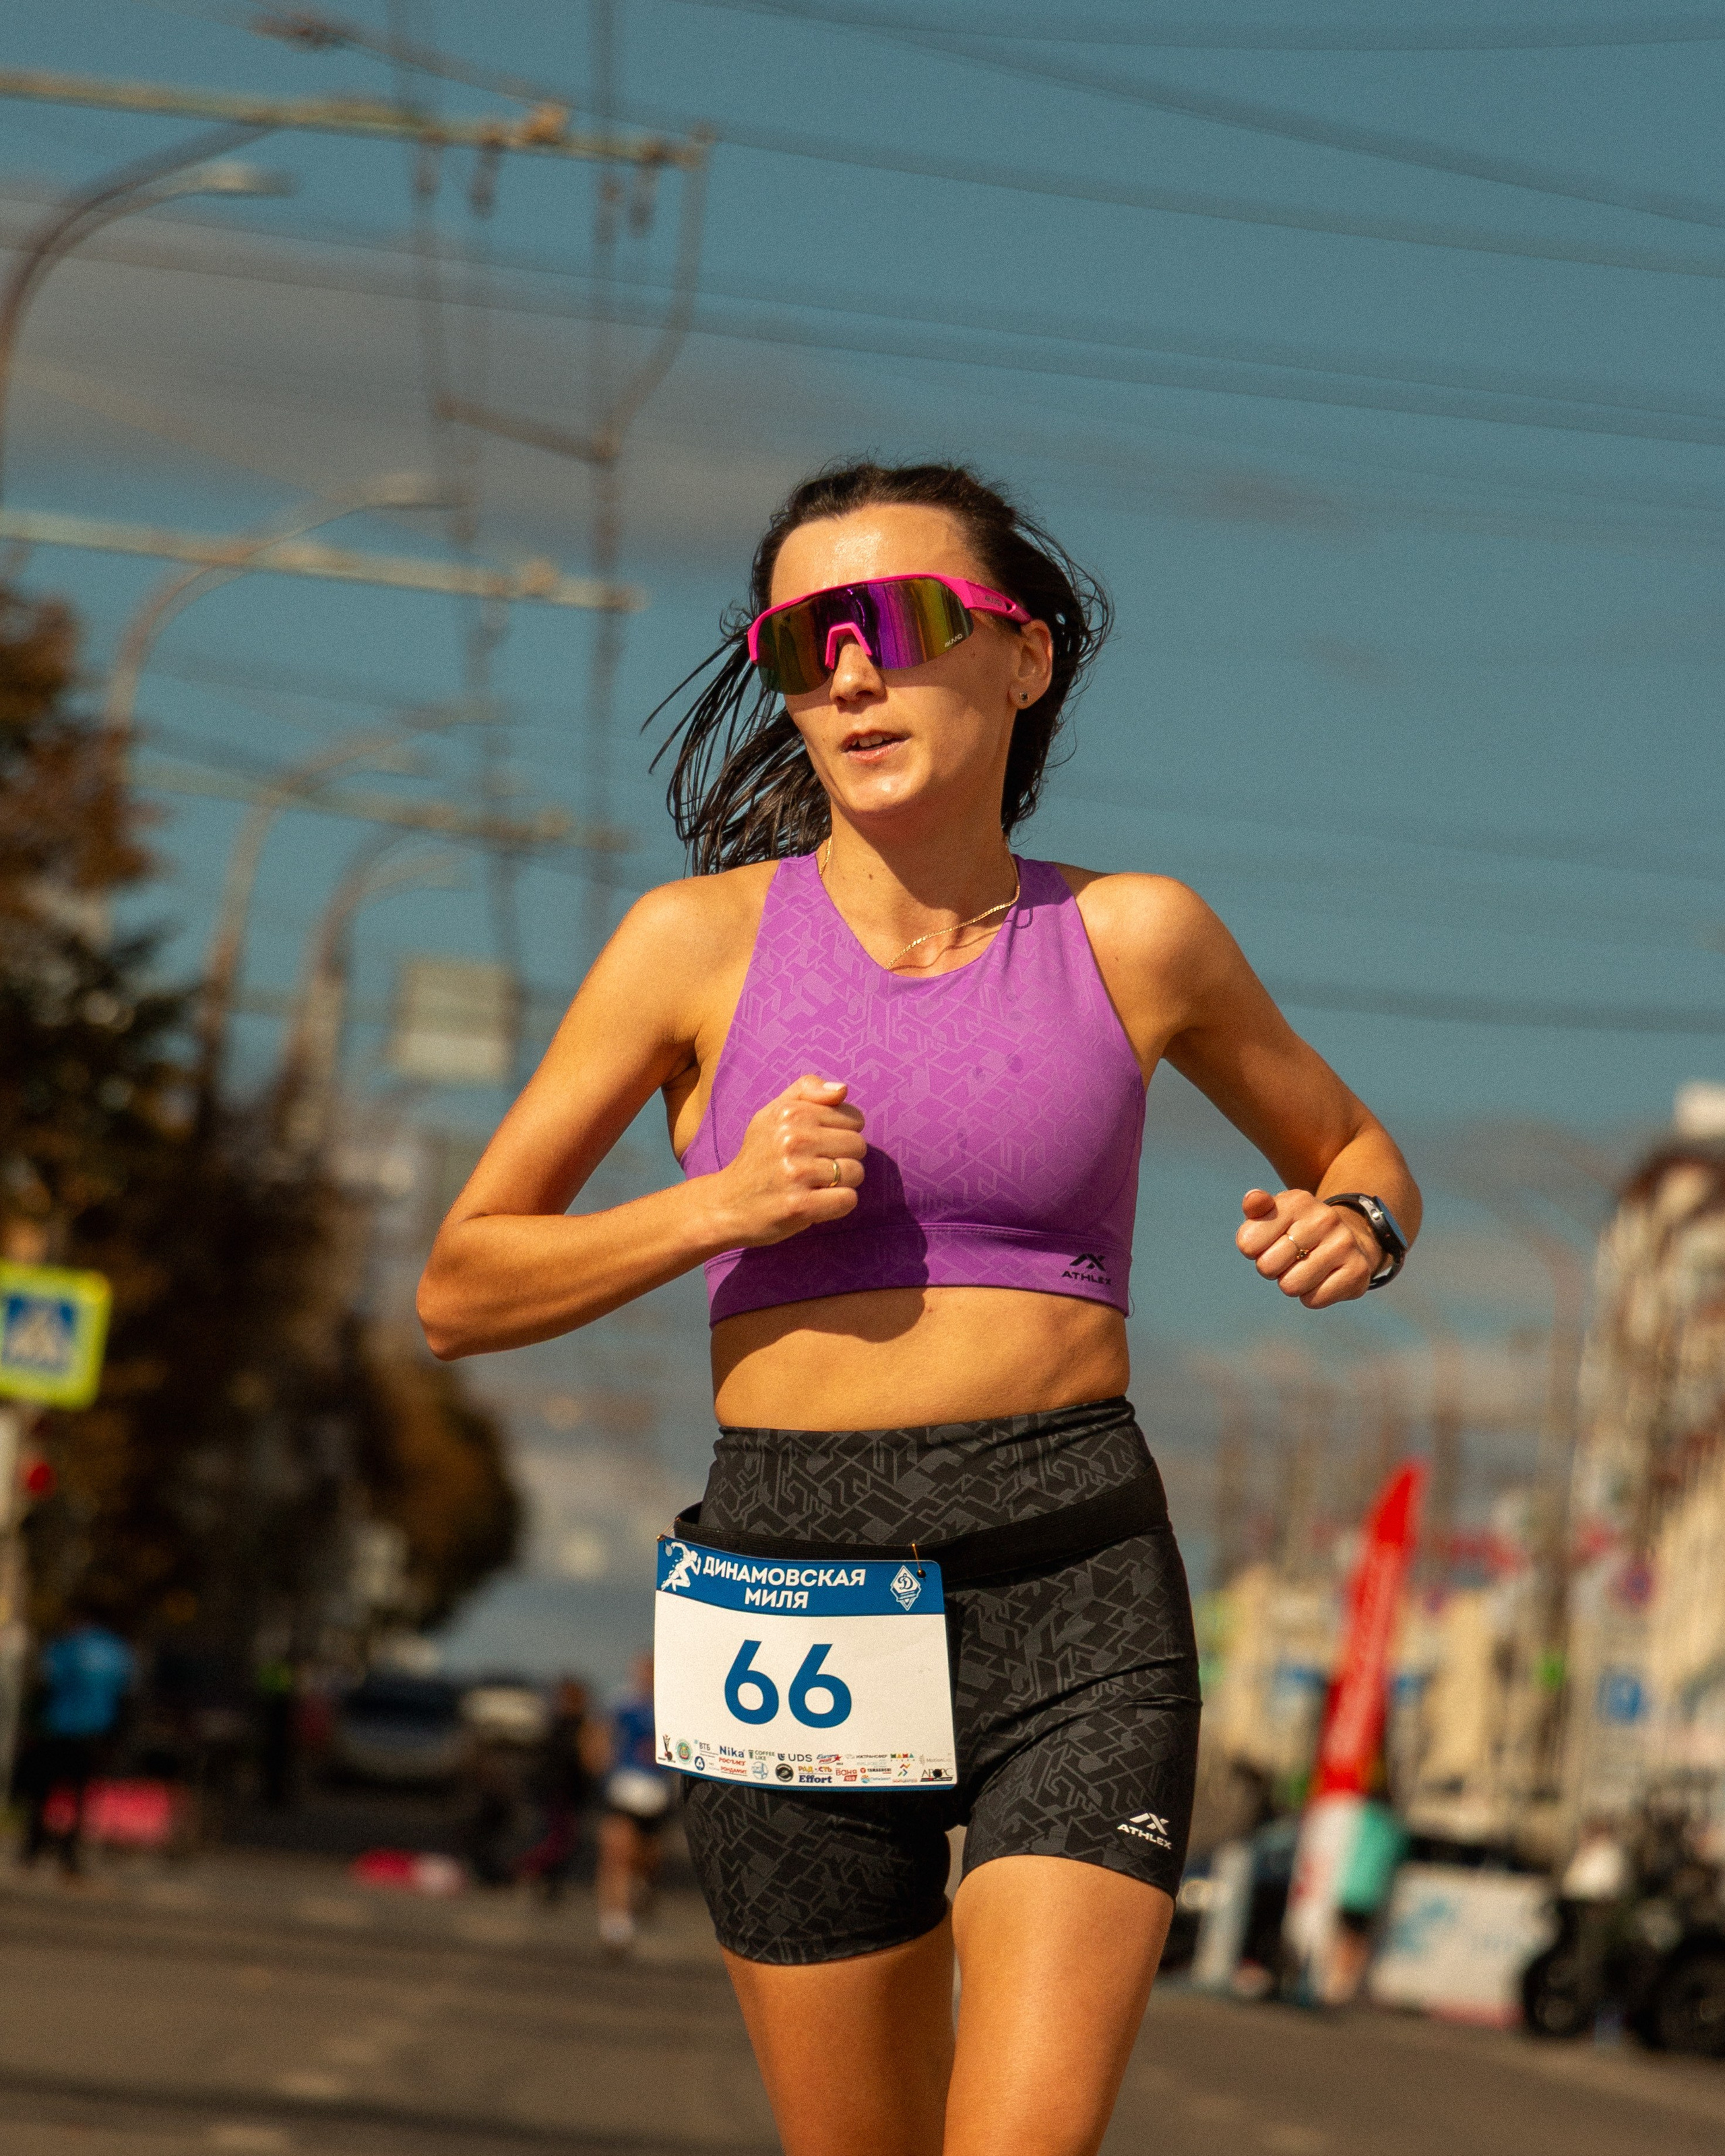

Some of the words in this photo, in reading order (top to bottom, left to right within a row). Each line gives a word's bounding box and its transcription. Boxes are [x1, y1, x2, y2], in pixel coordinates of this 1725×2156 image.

[1061, 1271, 1111, 1286] ATHLEX
[703, 1556, 866, 1587] ДИНАМОВСКАЯ
[745, 1587, 809, 1609] МИЛЯ
[724, 1639, 852, 1728] 66
[720, 1746, 745, 1758] Nika
[788, 1754, 813, 1762] UDS
[1117, 1824, 1172, 1849] ATHLEX
